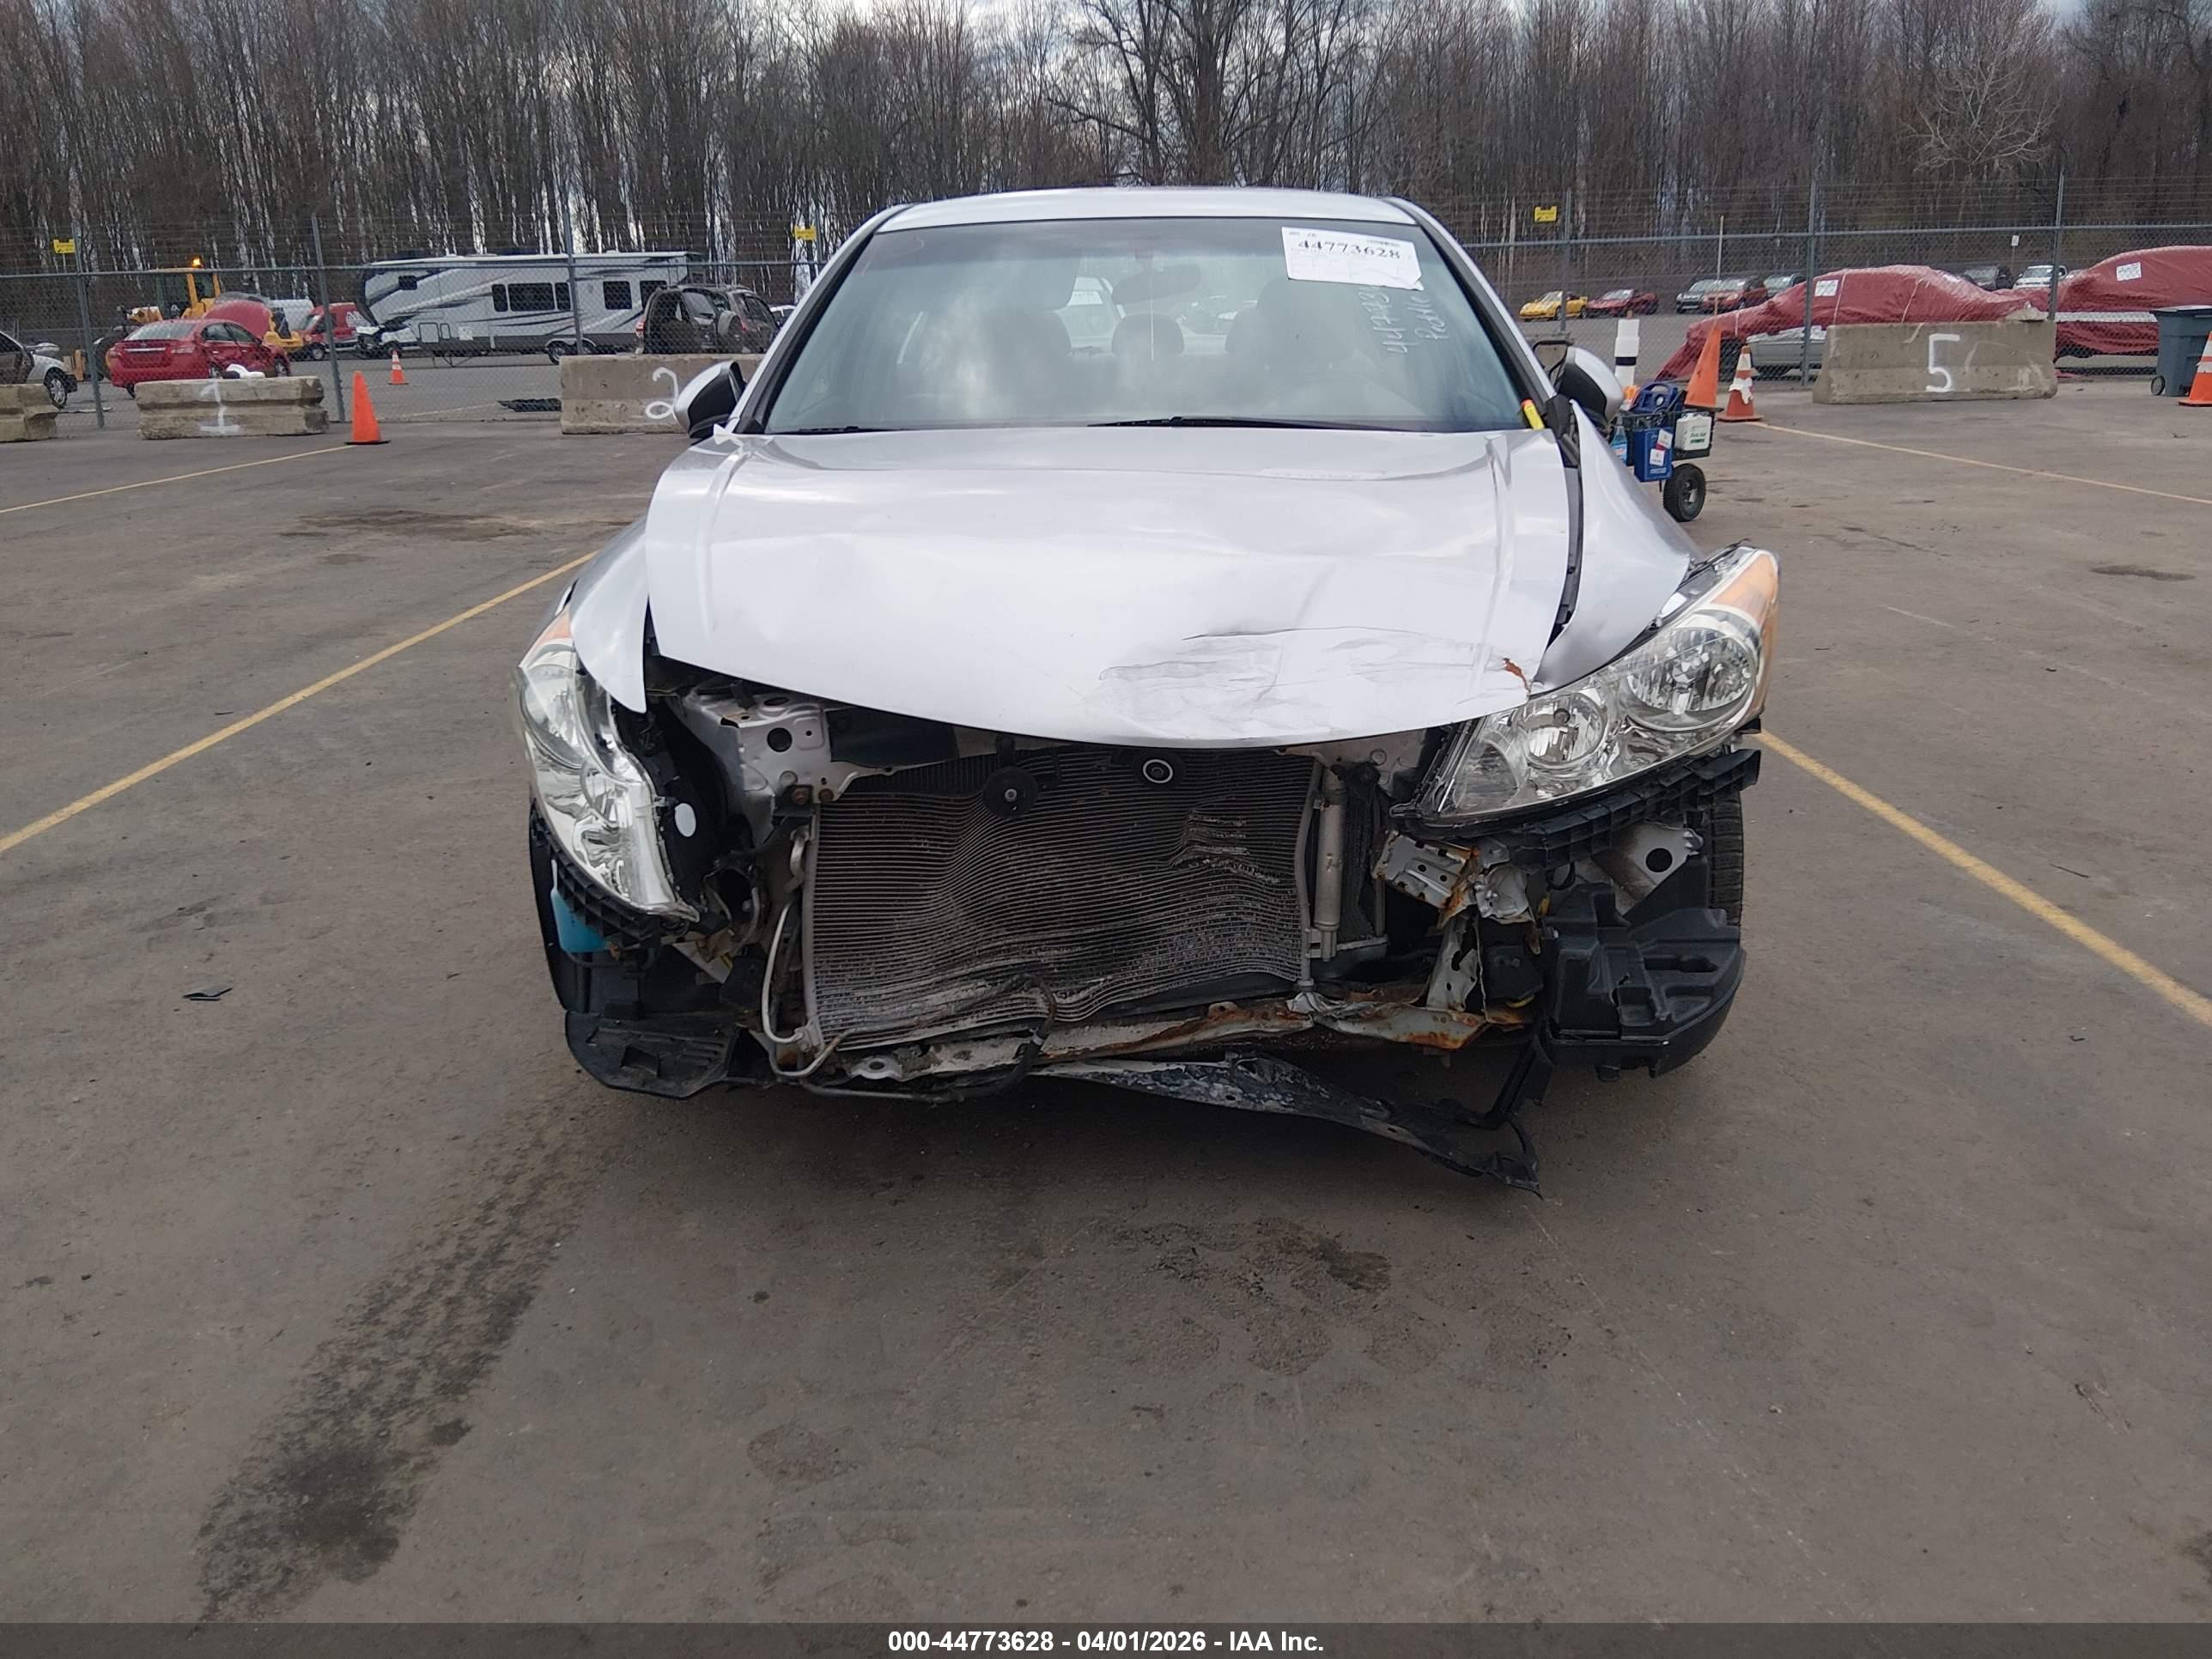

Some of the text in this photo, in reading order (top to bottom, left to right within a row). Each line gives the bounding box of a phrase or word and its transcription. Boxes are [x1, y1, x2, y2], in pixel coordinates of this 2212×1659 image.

[1298, 240, 1401, 260] 44773628
[1925, 333, 1960, 393] 5
[200, 380, 242, 434] 1
[645, 367, 679, 421] 2
